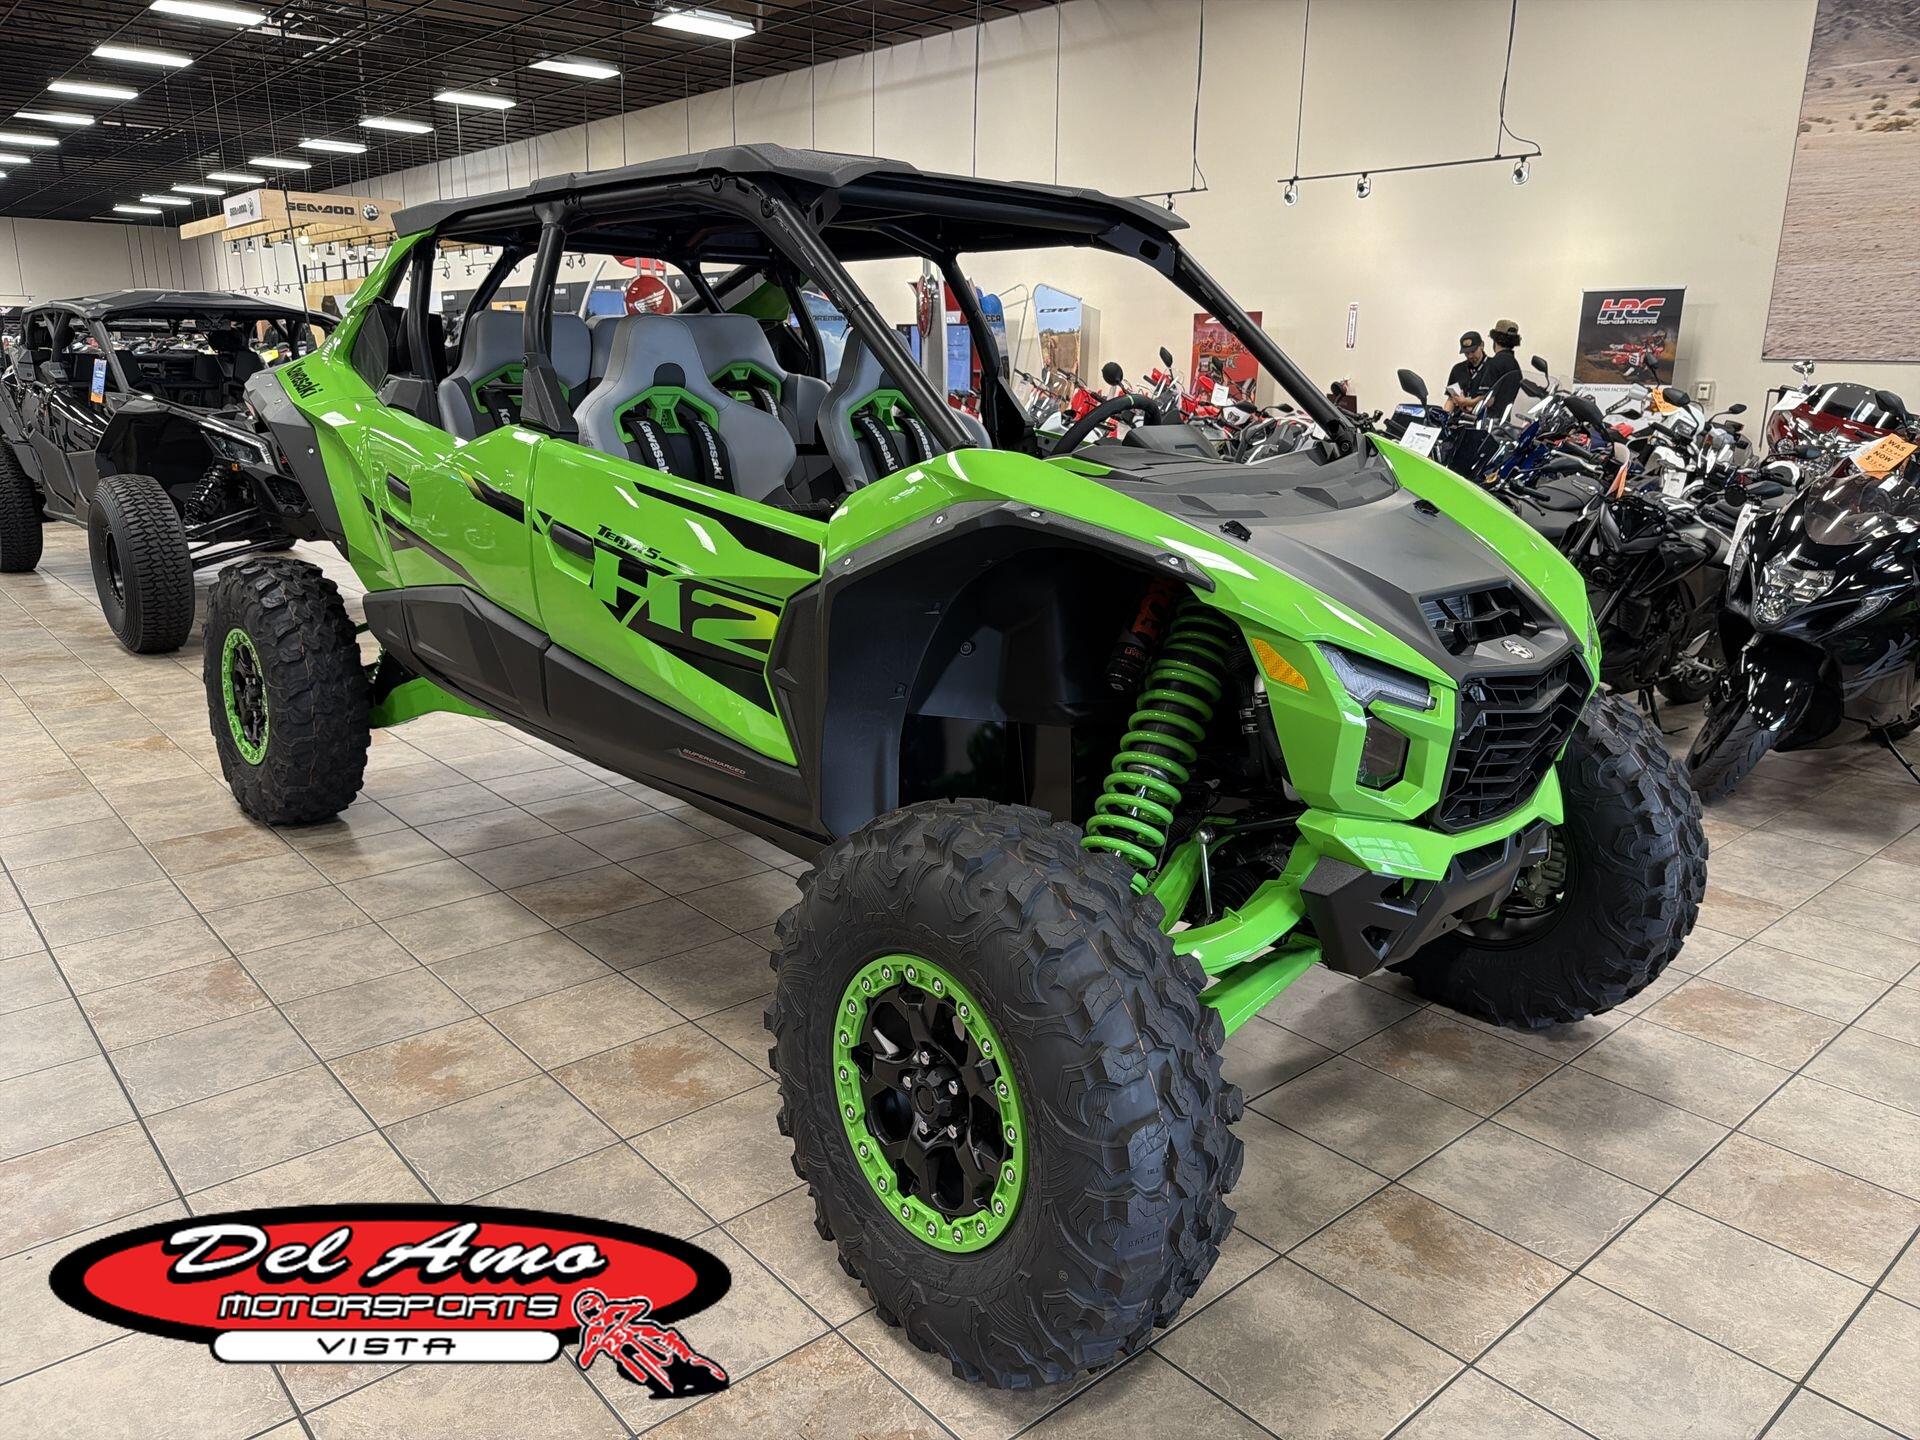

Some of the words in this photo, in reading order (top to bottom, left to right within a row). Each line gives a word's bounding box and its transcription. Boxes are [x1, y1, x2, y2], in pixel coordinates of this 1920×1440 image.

[1597, 298, 1666, 320] HRC
[285, 360, 324, 399] Kawasaki
[636, 420, 673, 474] Kawasak
[861, 416, 899, 471] Kawasaki
[907, 418, 932, 459] Kawasa
[1873, 450, 1894, 463] NOW
[592, 546, 779, 655] H2
[682, 748, 746, 775] SUPERCHARGED
